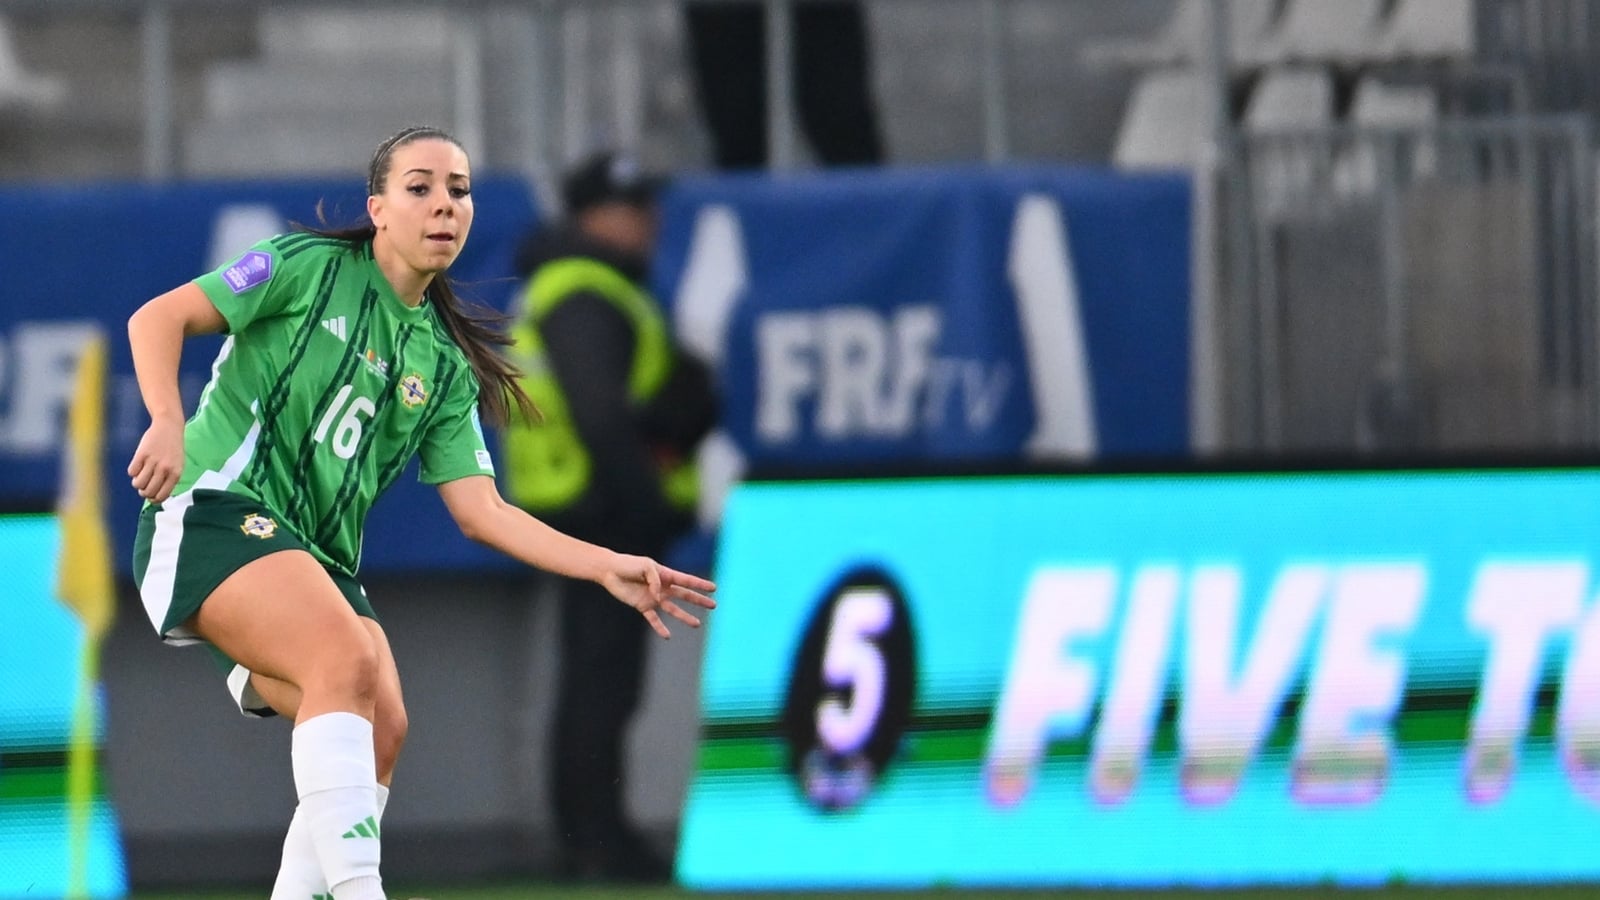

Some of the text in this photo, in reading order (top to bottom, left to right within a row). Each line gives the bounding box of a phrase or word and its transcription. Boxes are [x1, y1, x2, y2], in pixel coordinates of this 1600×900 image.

[313, 384, 376, 459] 16
[757, 309, 1010, 437] FRF TV
[815, 588, 894, 754] 5
[985, 562, 1427, 806] FIVE
